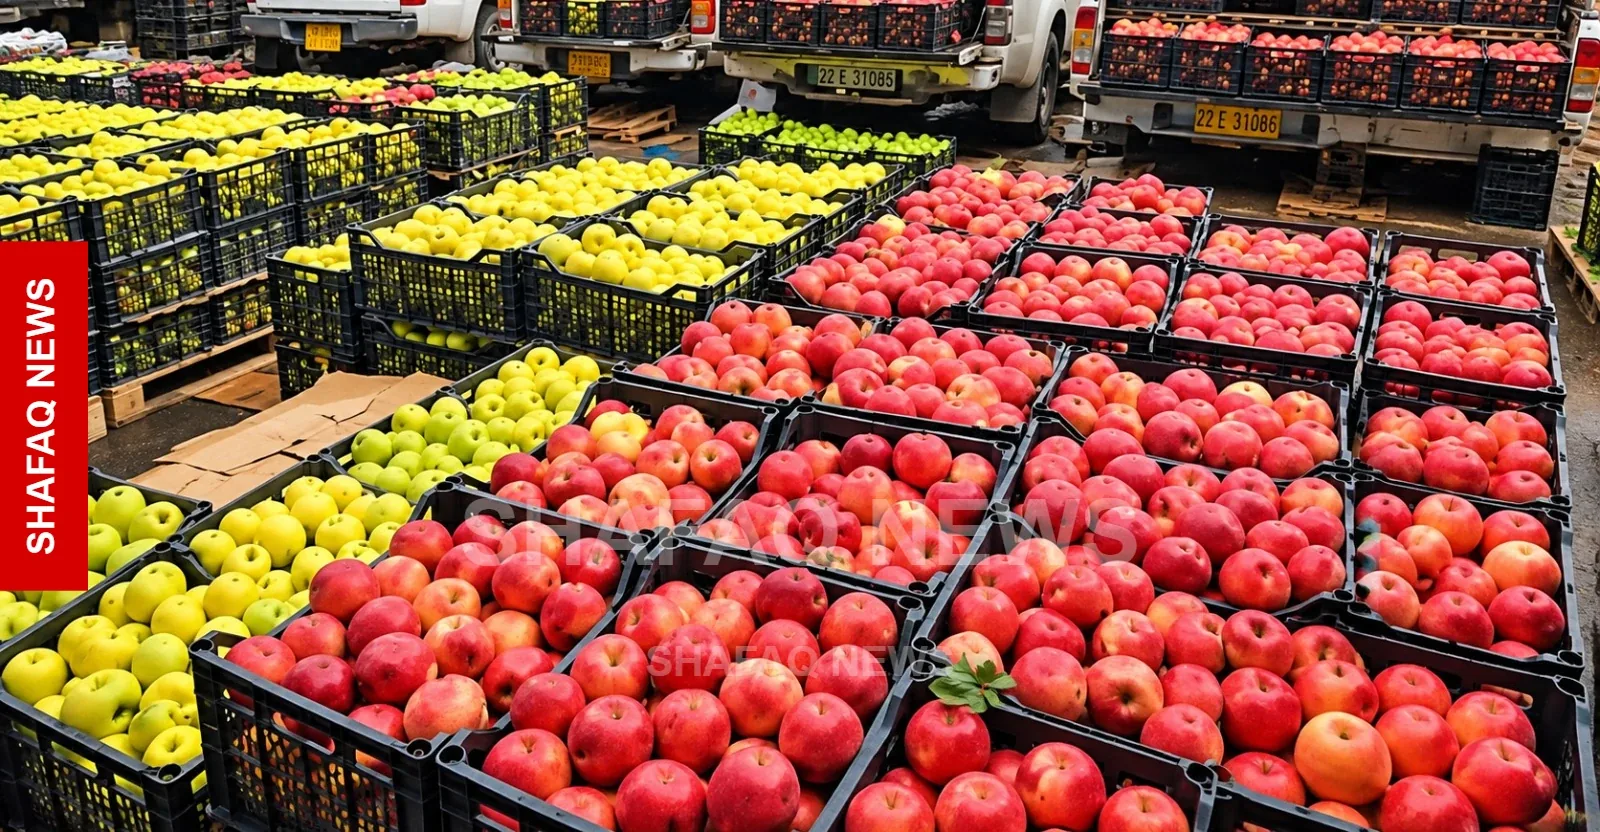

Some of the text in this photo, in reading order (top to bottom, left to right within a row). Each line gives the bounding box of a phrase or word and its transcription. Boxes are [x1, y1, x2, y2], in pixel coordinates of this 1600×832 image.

[819, 68, 834, 84] 22
[839, 69, 847, 85] E
[1196, 108, 1277, 133] 22 E 31086
